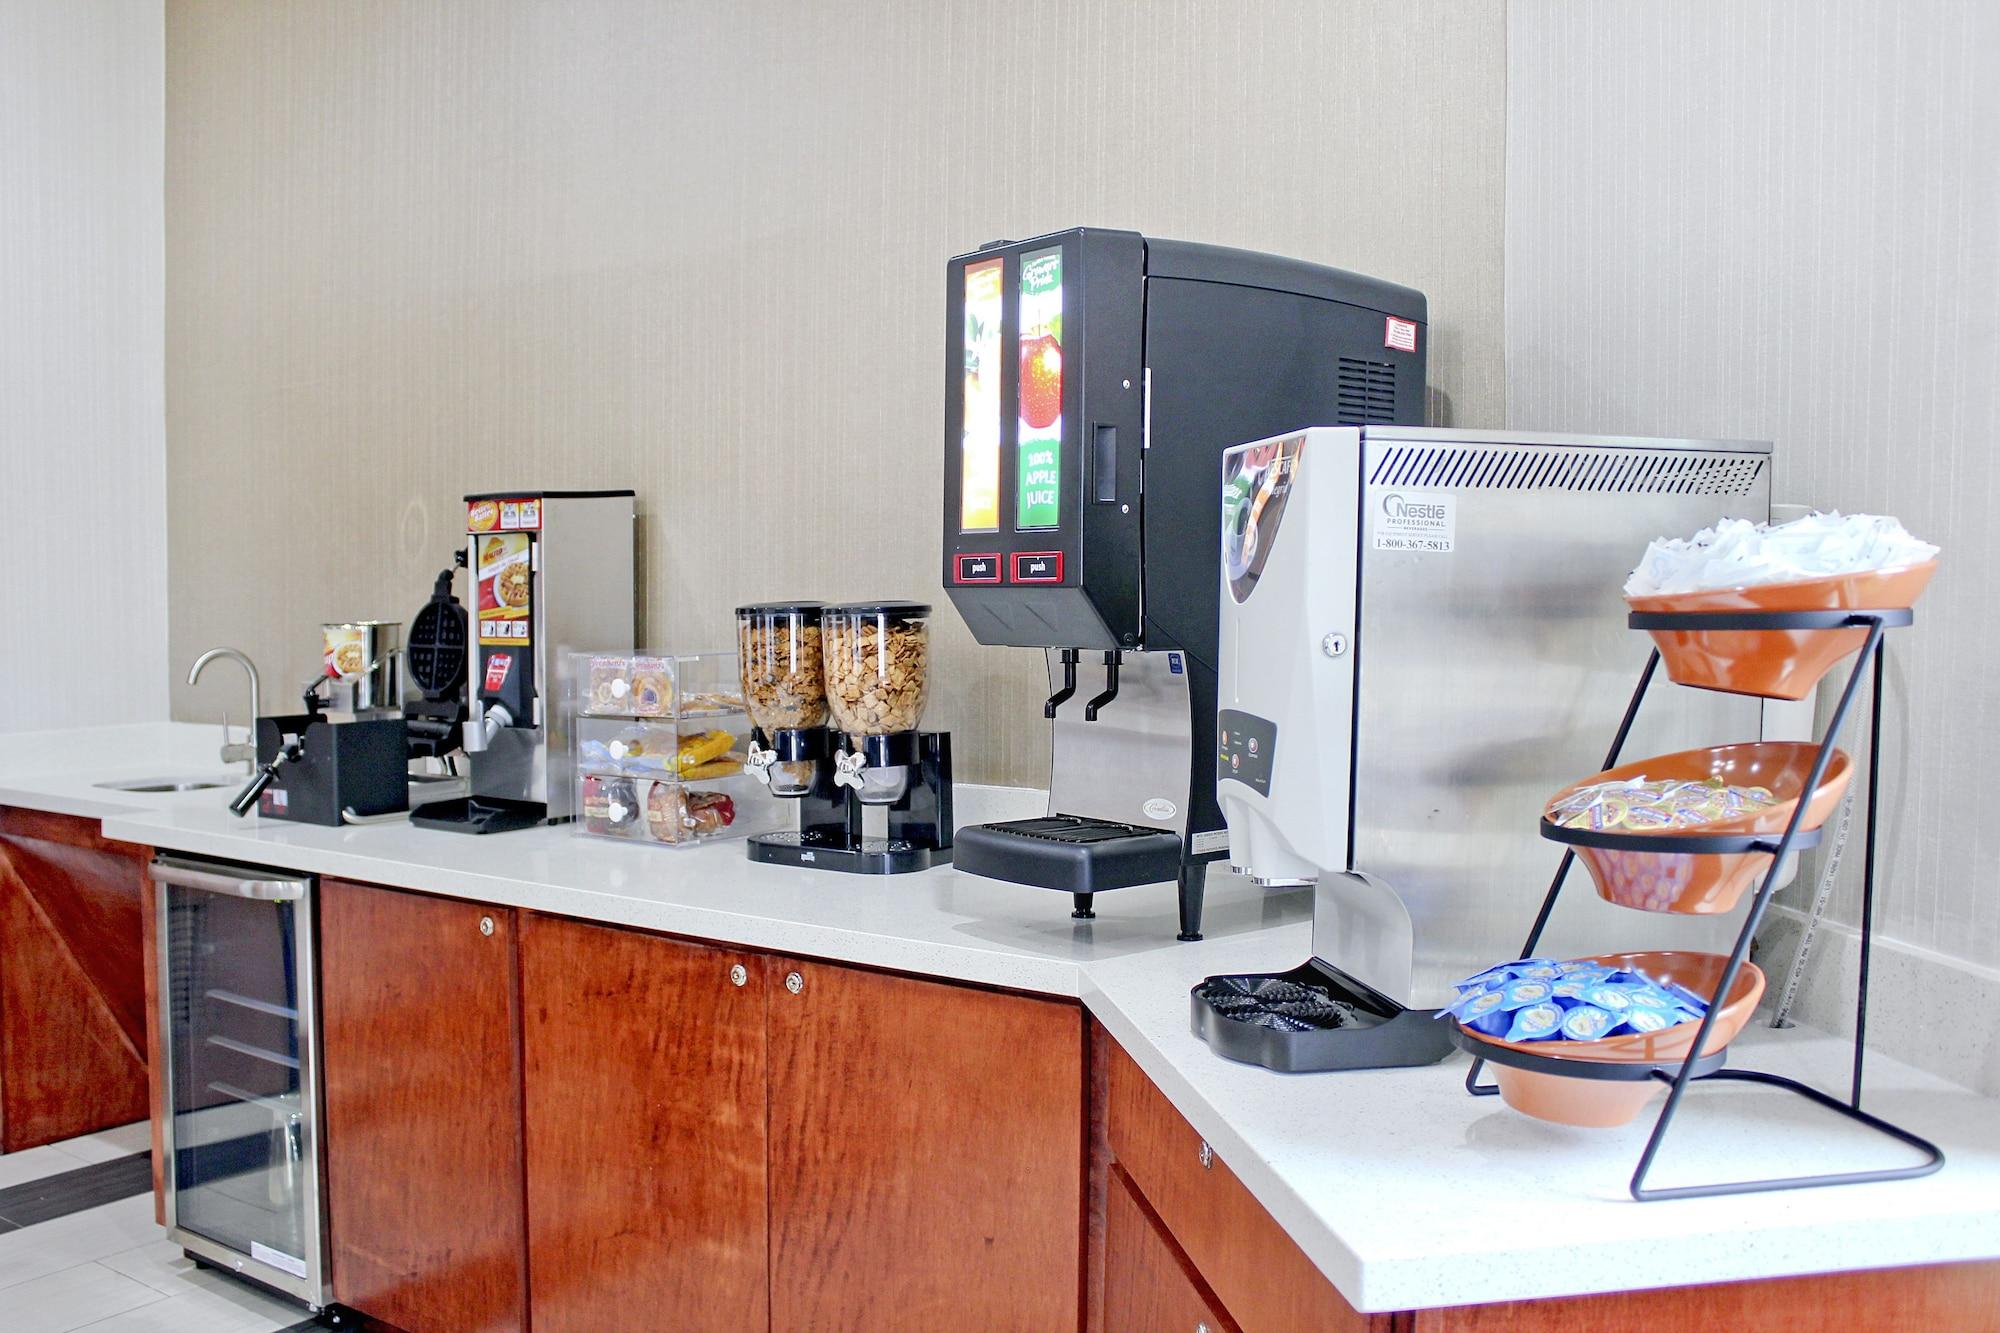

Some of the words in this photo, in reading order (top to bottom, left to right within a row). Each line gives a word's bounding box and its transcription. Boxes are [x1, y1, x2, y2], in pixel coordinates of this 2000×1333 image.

[1027, 449, 1054, 467] 100%
[1025, 469, 1057, 486] APPLE
[1026, 489, 1055, 509] JUICE
[1386, 518, 1446, 528] PROFESSIONAL
[1377, 539, 1450, 551] 1-800-367-5813
[972, 562, 986, 574] push
[1030, 562, 1046, 574] push
